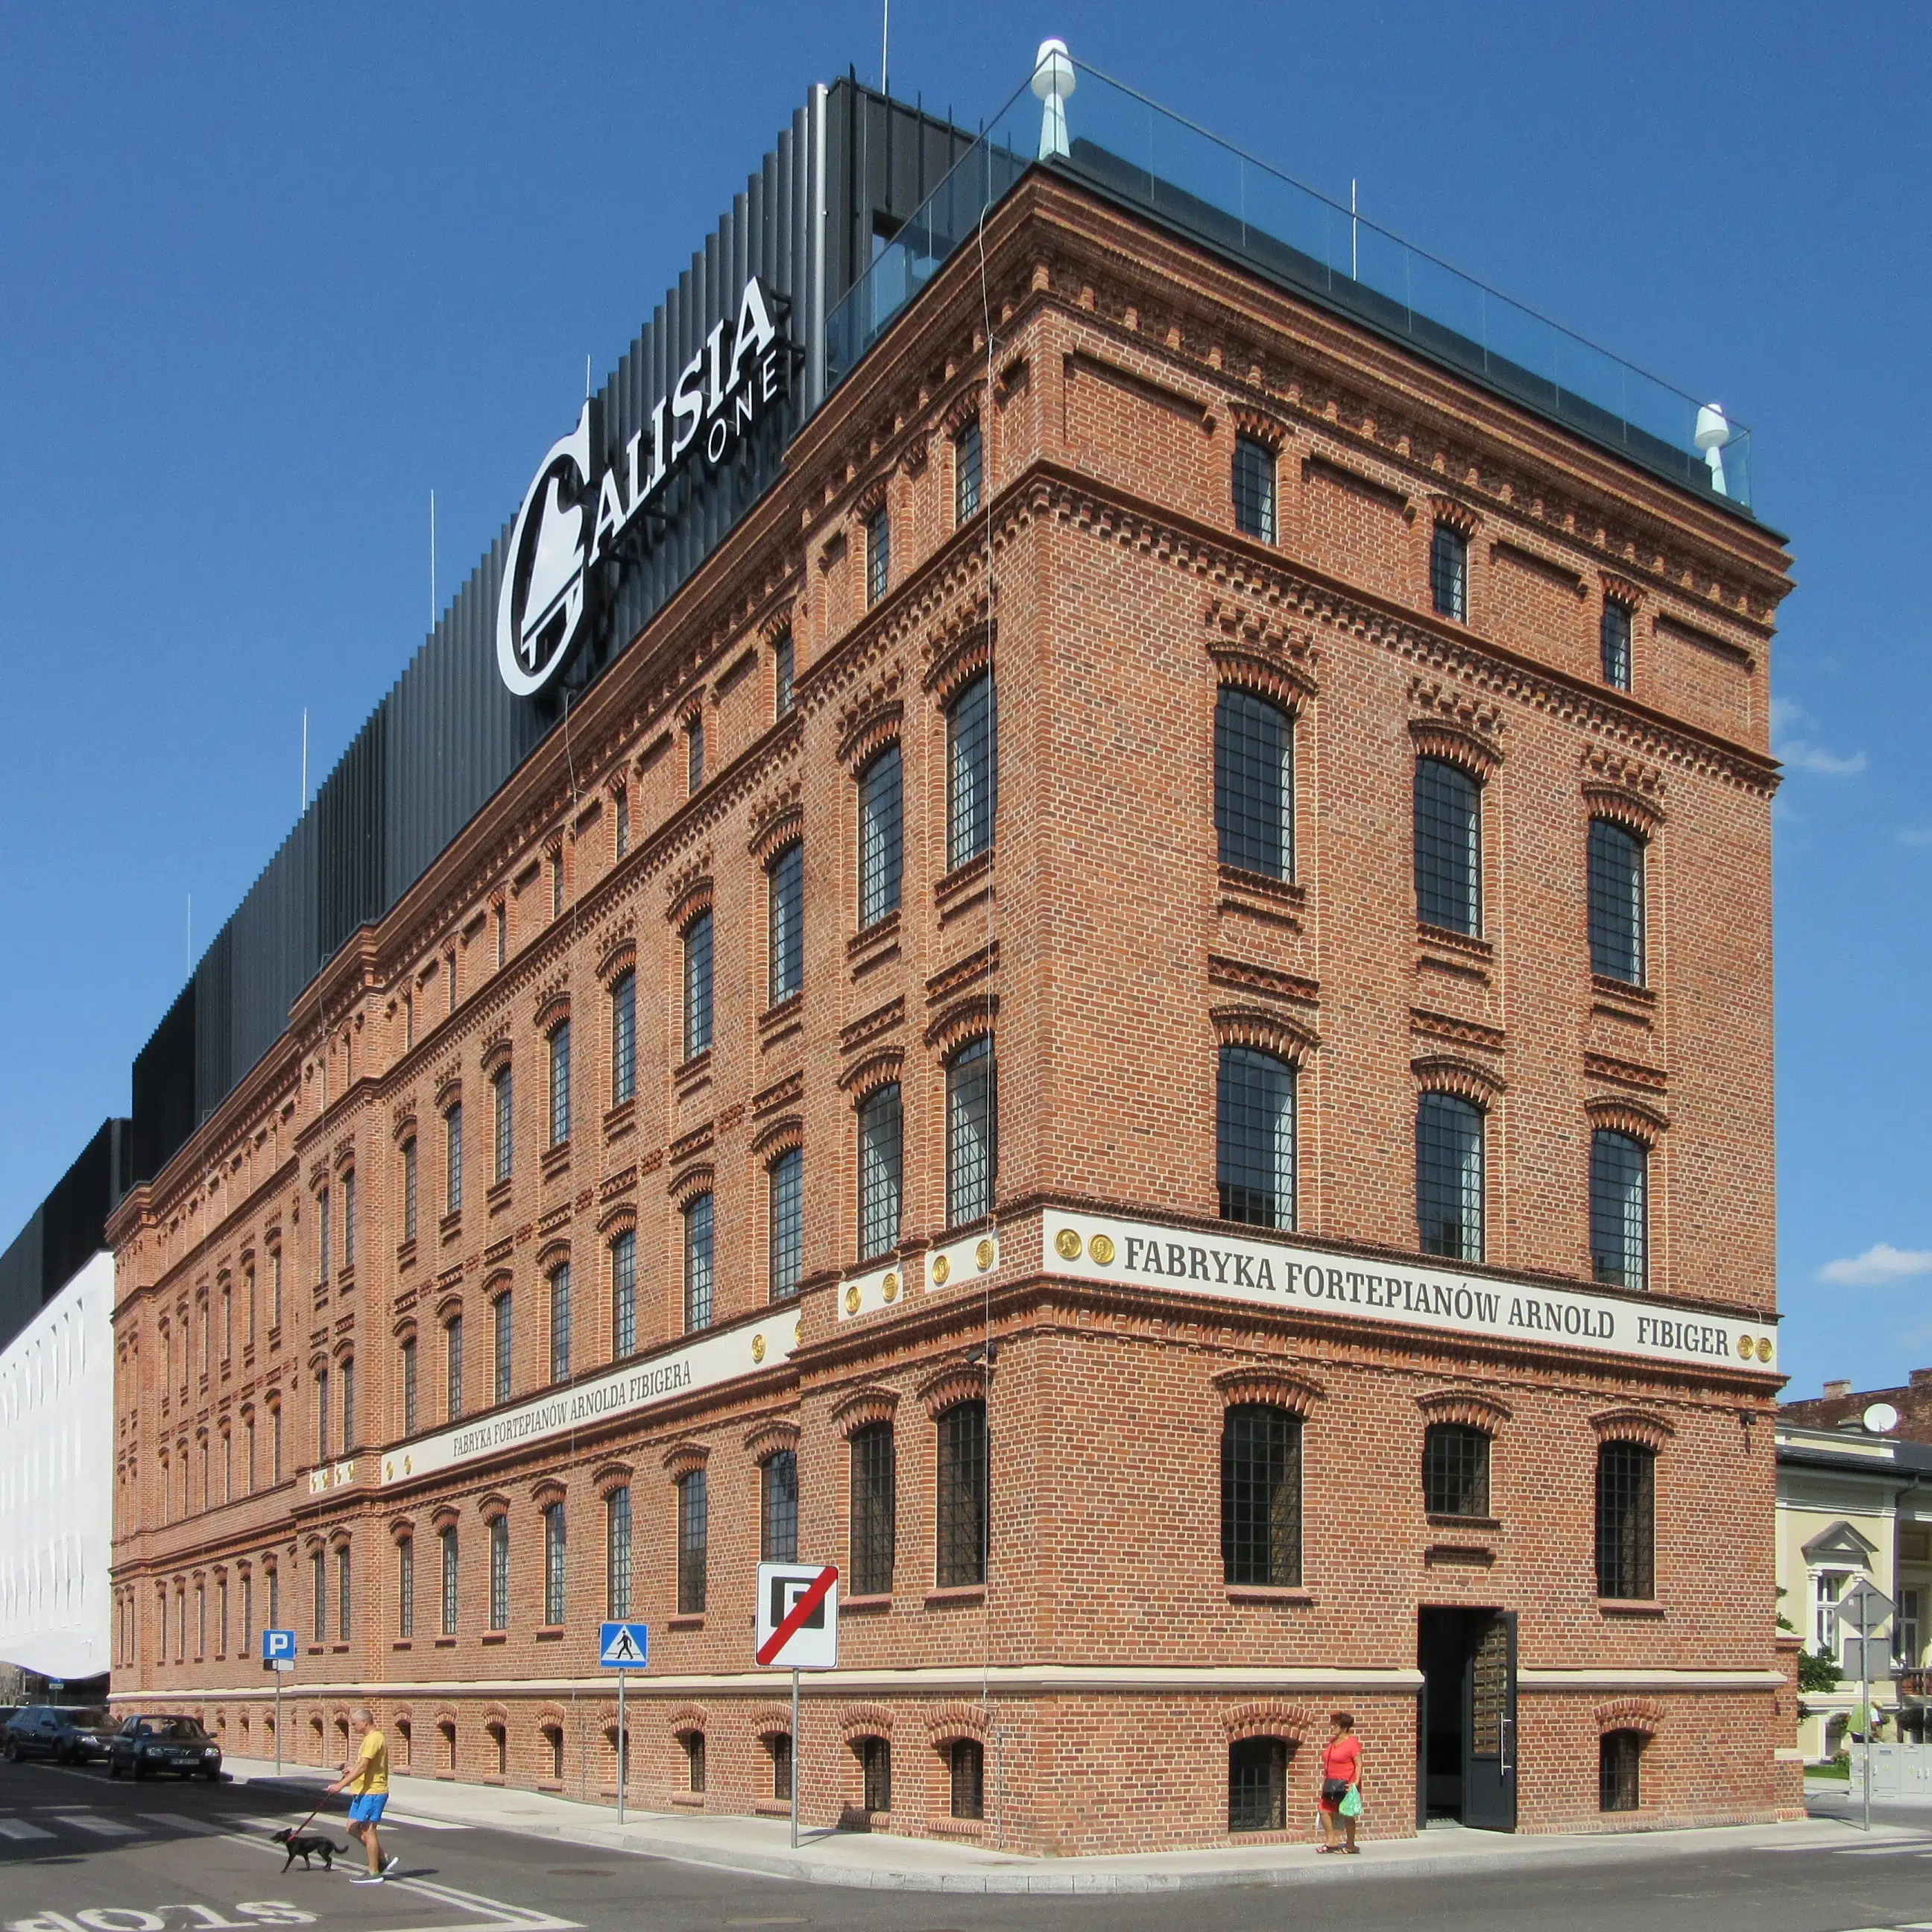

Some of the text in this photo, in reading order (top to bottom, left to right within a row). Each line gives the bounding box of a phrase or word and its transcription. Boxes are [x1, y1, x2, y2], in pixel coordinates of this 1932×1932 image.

[708, 350, 777, 463] ONE
[497, 276, 776, 695] CALISIA
[1124, 1237, 1729, 1357] FABRYKA FORTEPIANÓW ARNOLD FIBIGER
[453, 1360, 692, 1457] FABRYKA FORTEPIANÓW ARNOLDA FIBIGERA
[270, 1633, 288, 1655] P
